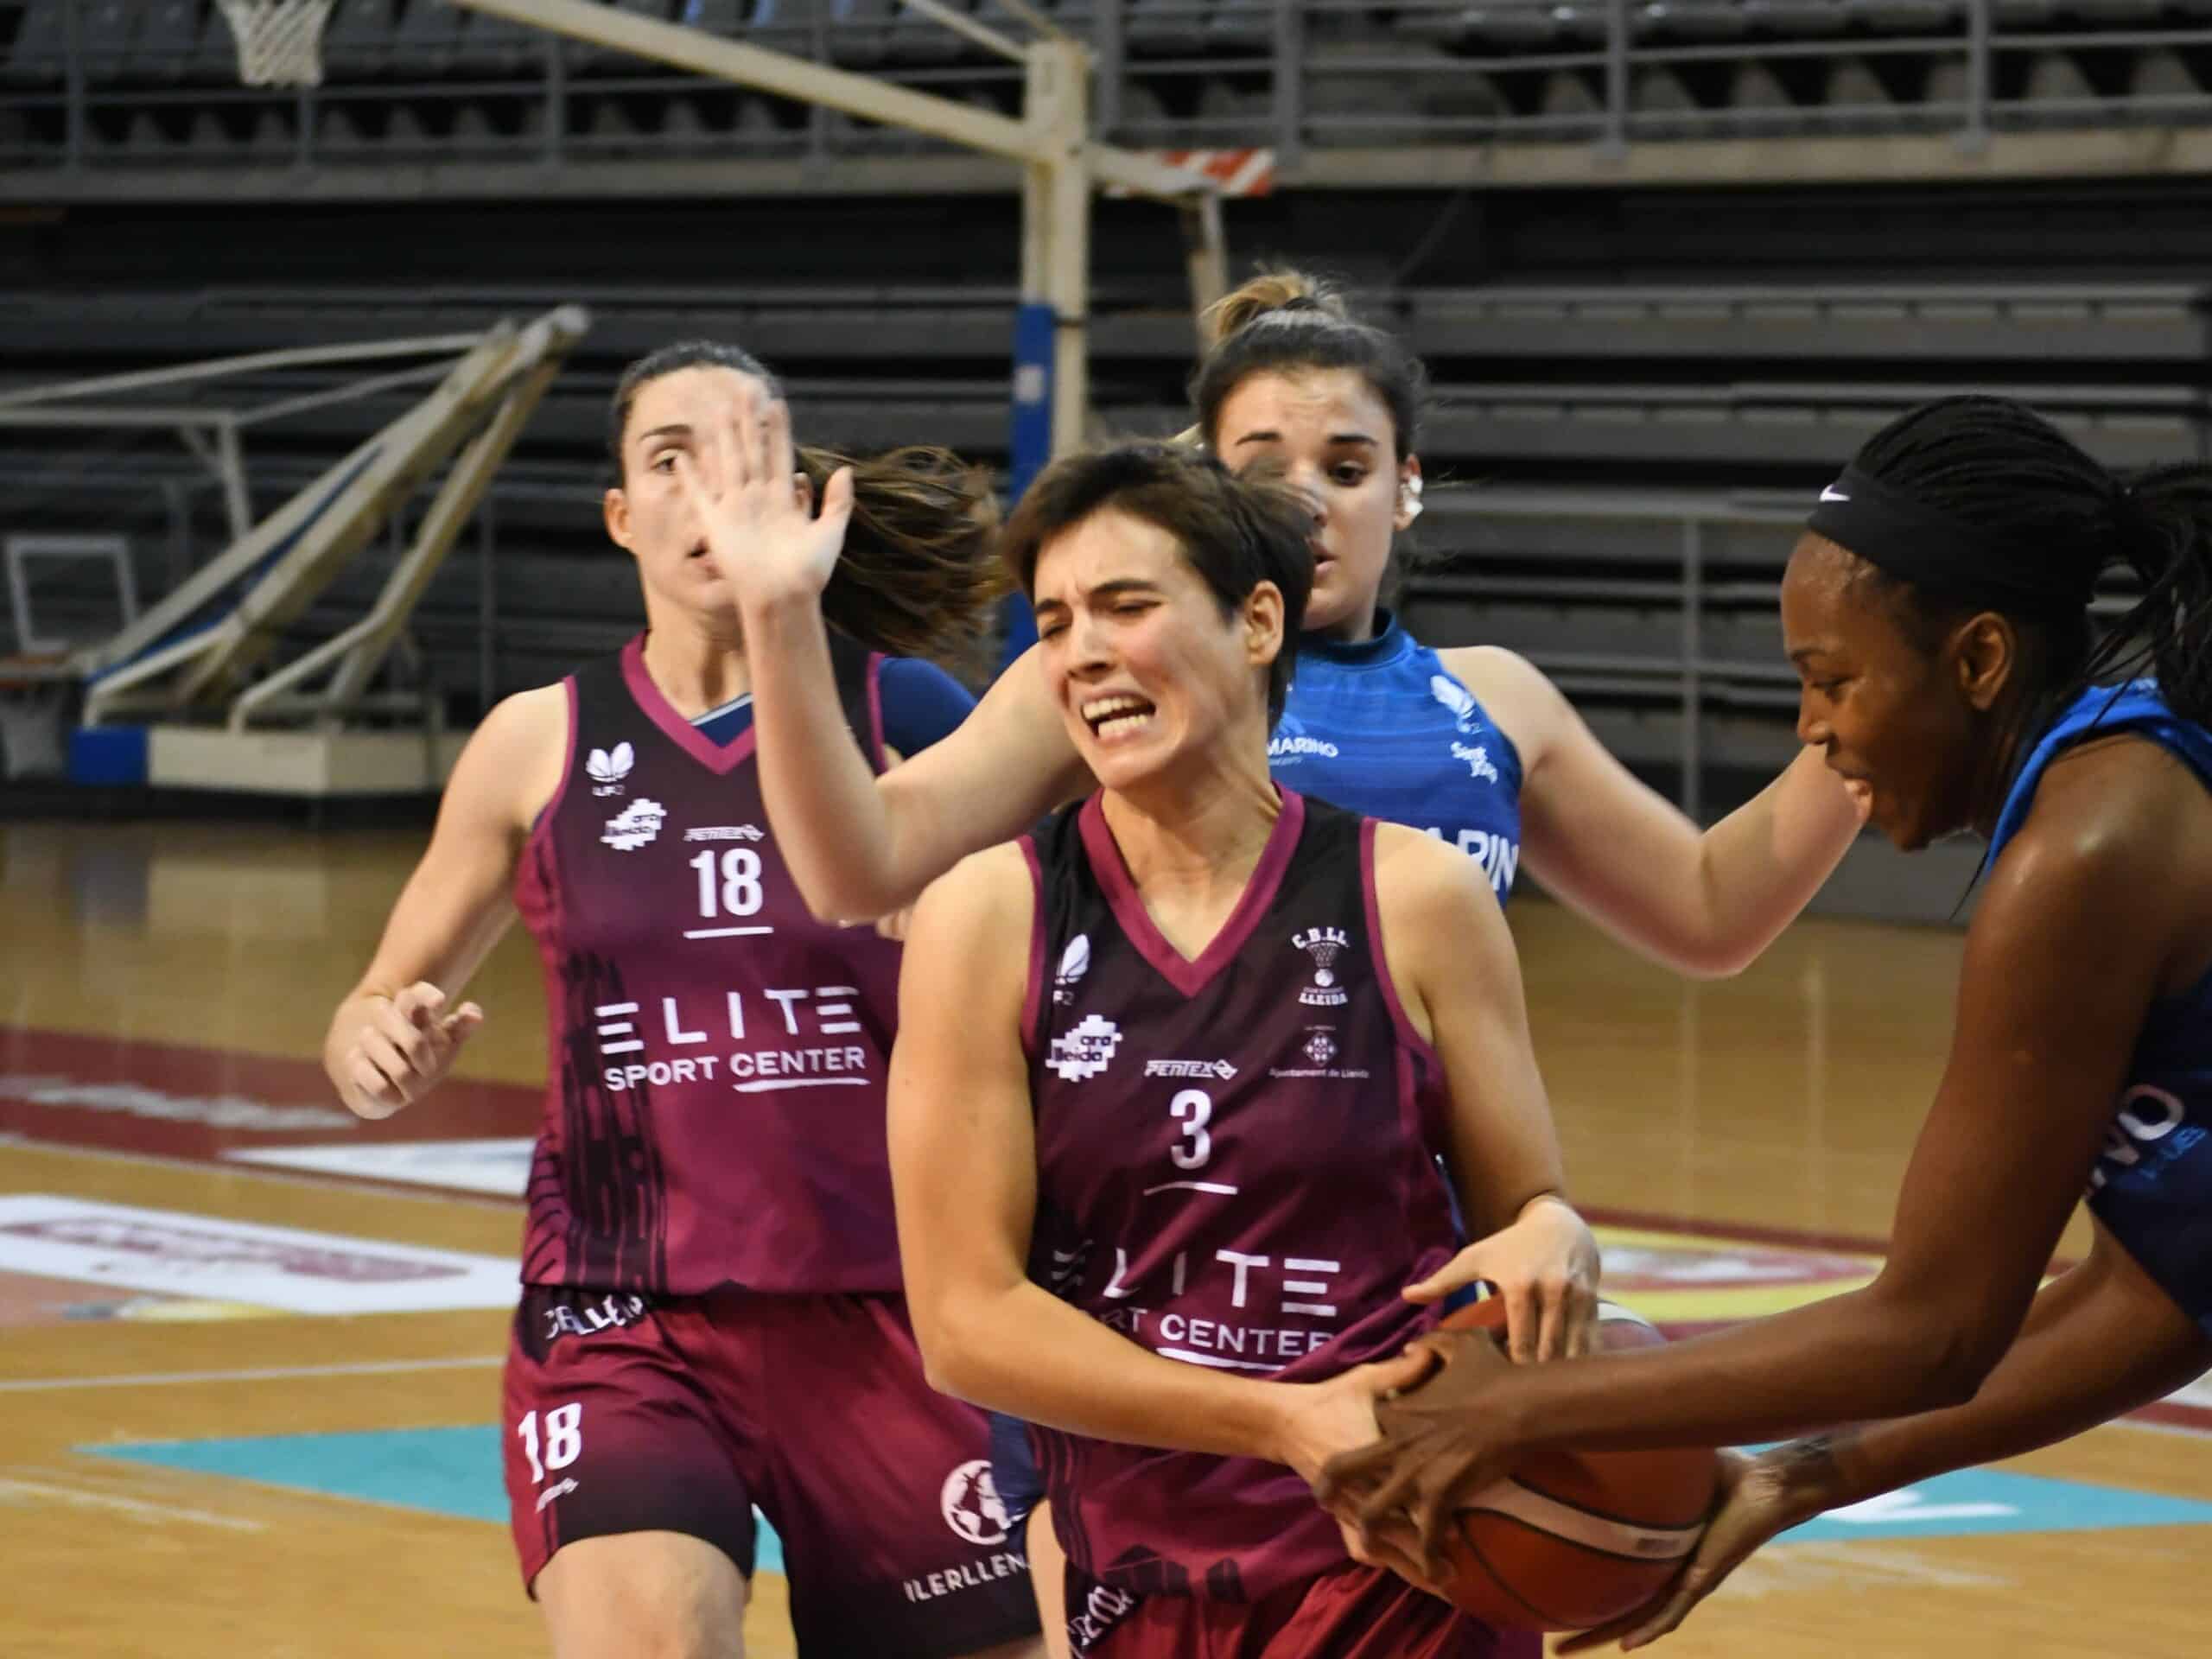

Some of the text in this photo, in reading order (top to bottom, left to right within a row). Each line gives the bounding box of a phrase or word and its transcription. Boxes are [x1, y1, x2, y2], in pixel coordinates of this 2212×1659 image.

[690, 848, 763, 918] 18
[594, 986, 861, 1054] ELITE
[604, 1046, 867, 1090] SPORT CENTER
[1144, 1060, 1214, 1077] PENTEX
[1170, 1089, 1211, 1169] 3
[518, 1402, 582, 1484] 18
